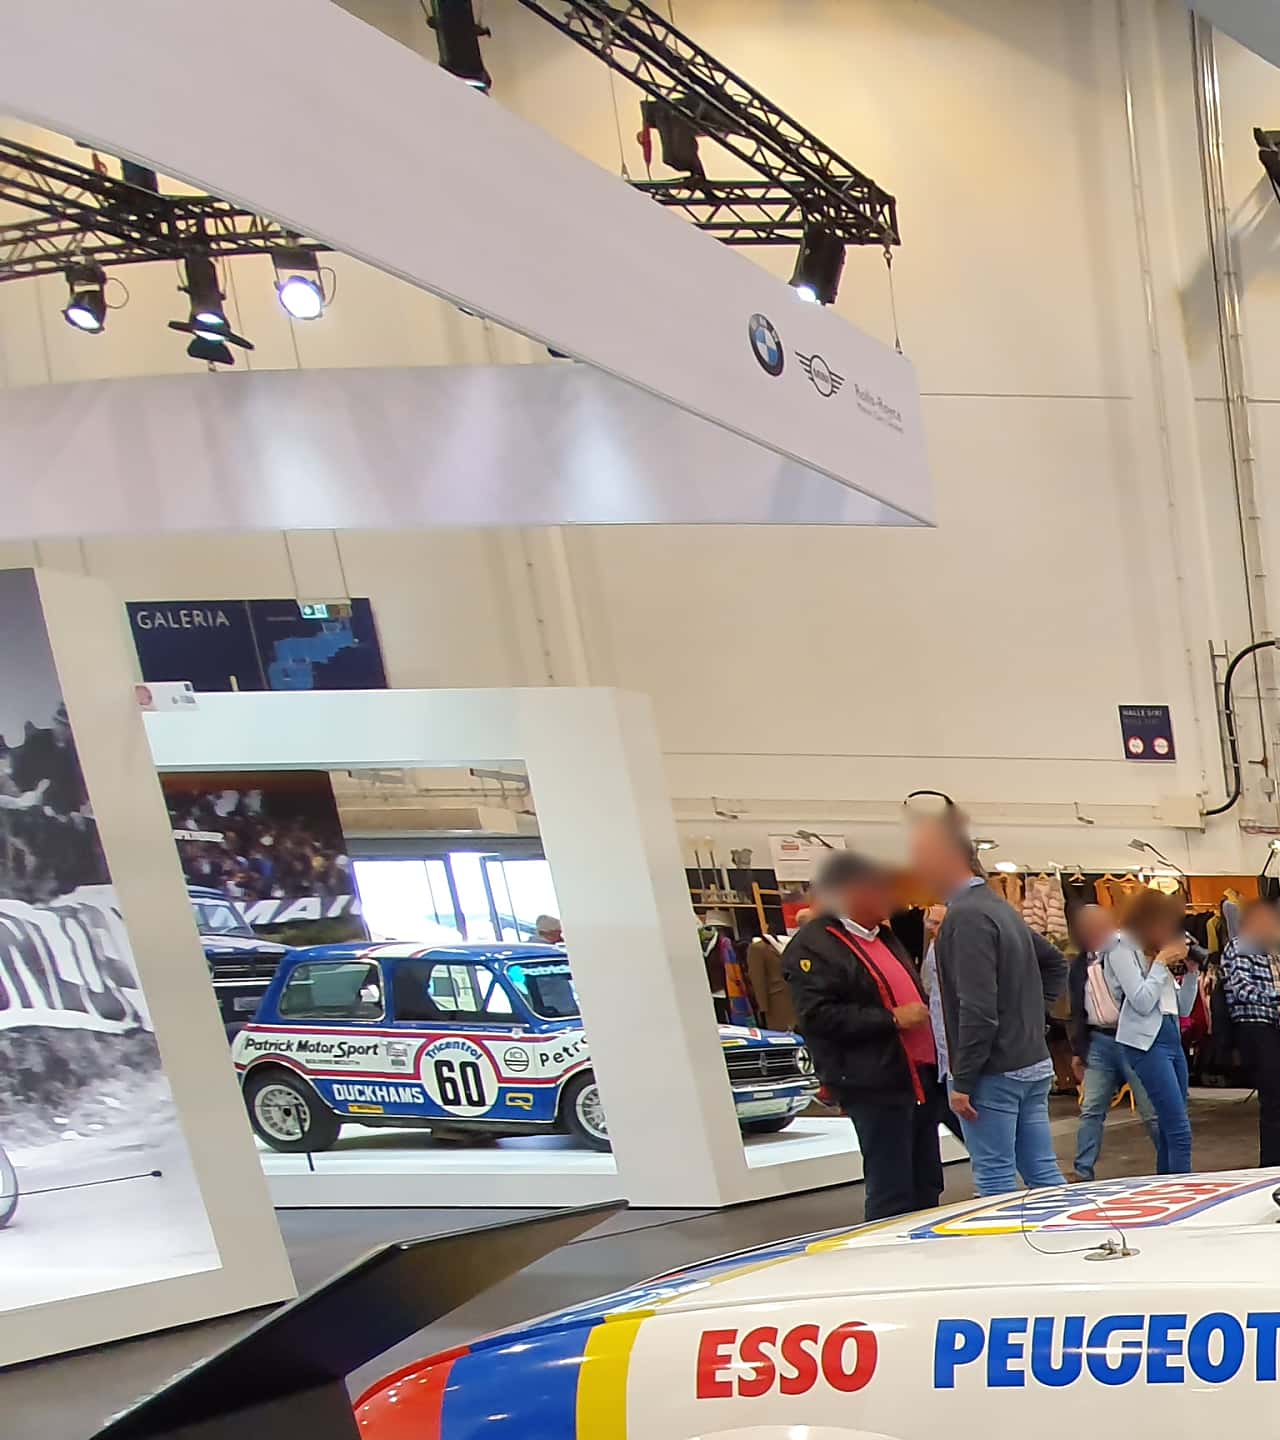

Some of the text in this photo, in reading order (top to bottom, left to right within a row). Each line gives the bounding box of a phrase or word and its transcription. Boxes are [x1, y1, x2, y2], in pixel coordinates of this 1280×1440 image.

[137, 610, 230, 629] GALERIA
[244, 1037, 294, 1053] Patrick
[424, 1041, 484, 1061] Tricentrol
[434, 1059, 487, 1107] 60
[332, 1083, 425, 1104] DUCKHAMS
[696, 1321, 878, 1399] ESSO
